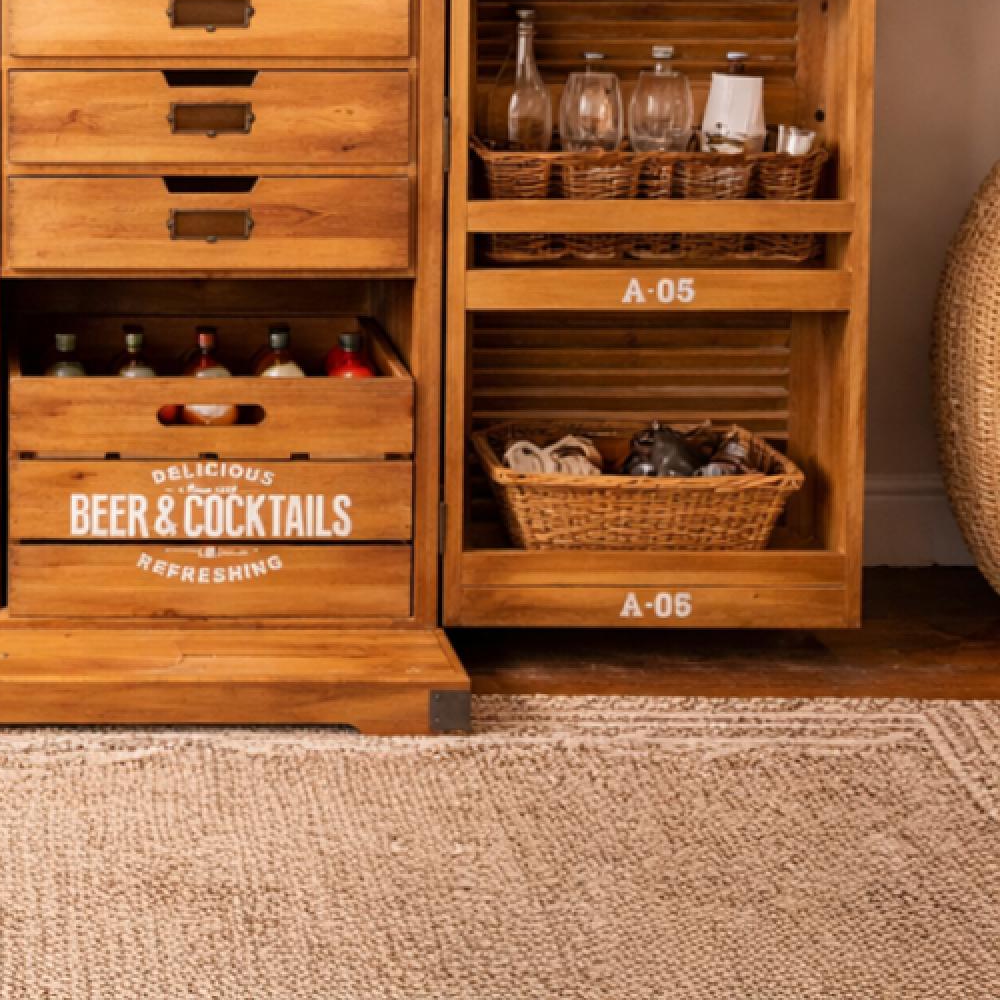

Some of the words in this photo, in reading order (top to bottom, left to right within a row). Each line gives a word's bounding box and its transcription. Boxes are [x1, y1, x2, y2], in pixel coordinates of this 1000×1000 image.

[151, 462, 275, 486] DELICIOUS
[70, 493, 149, 537] BEER
[154, 493, 178, 537] &
[184, 493, 352, 537] COCKTAILS
